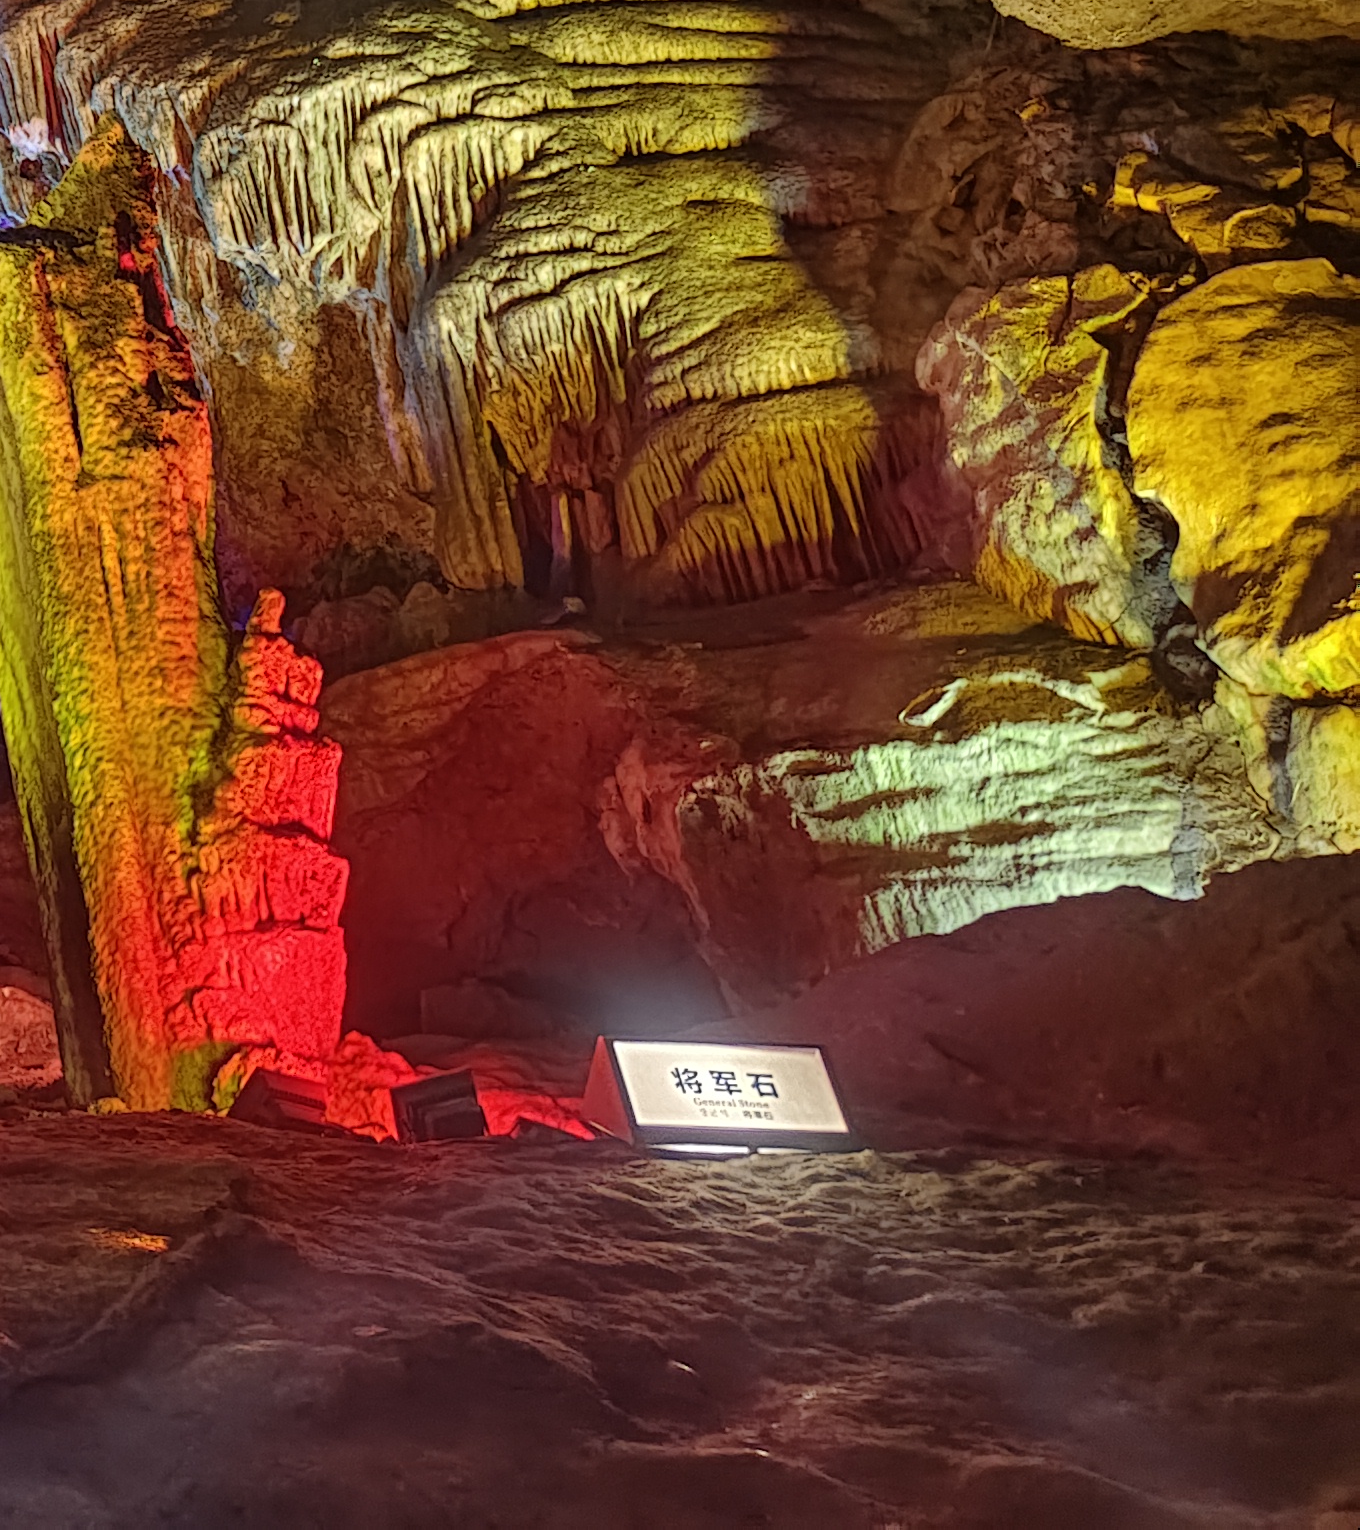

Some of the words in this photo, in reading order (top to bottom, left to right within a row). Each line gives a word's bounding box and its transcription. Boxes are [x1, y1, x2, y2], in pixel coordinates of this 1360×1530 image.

[670, 1067, 779, 1099] 将军石
[693, 1097, 737, 1107] General
[737, 1099, 770, 1109] Stone
